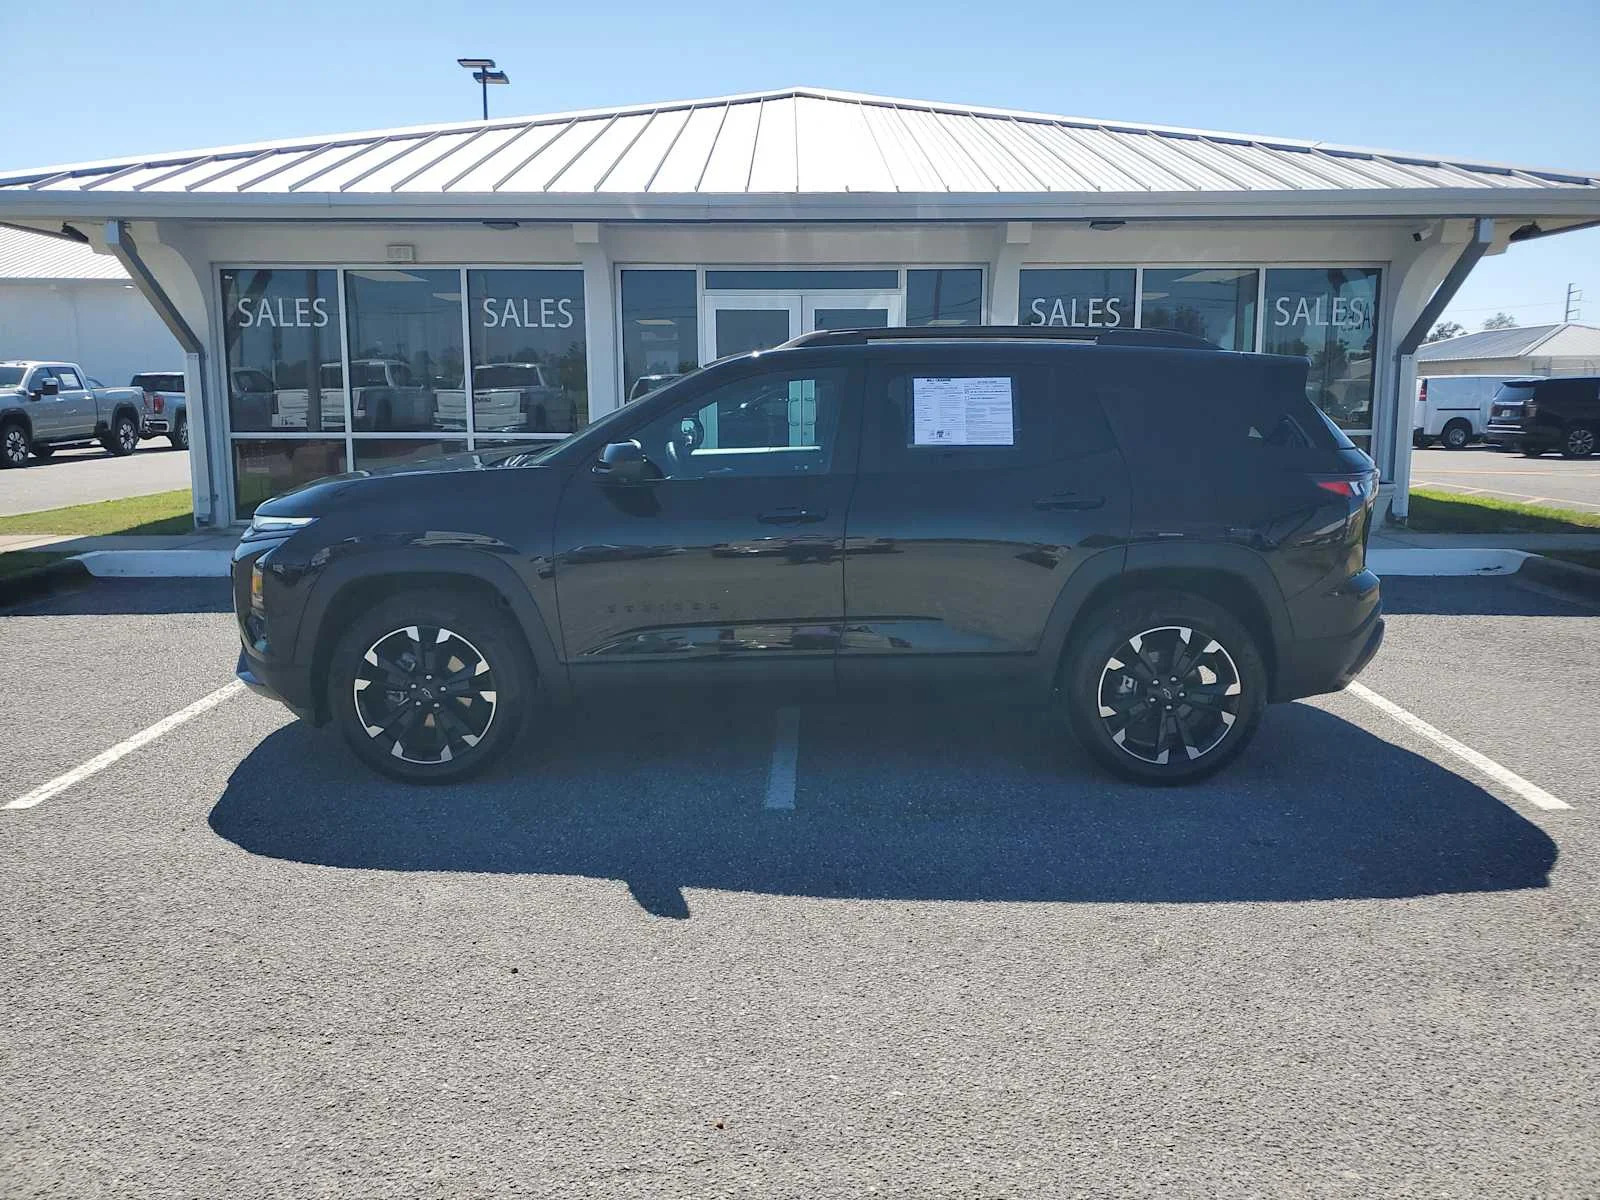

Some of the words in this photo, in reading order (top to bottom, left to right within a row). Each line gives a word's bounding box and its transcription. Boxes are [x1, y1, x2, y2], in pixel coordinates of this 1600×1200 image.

[238, 297, 329, 328] SALES
[483, 297, 573, 328] SALES
[1030, 297, 1121, 327] SALES
[1274, 296, 1364, 327] SALES
